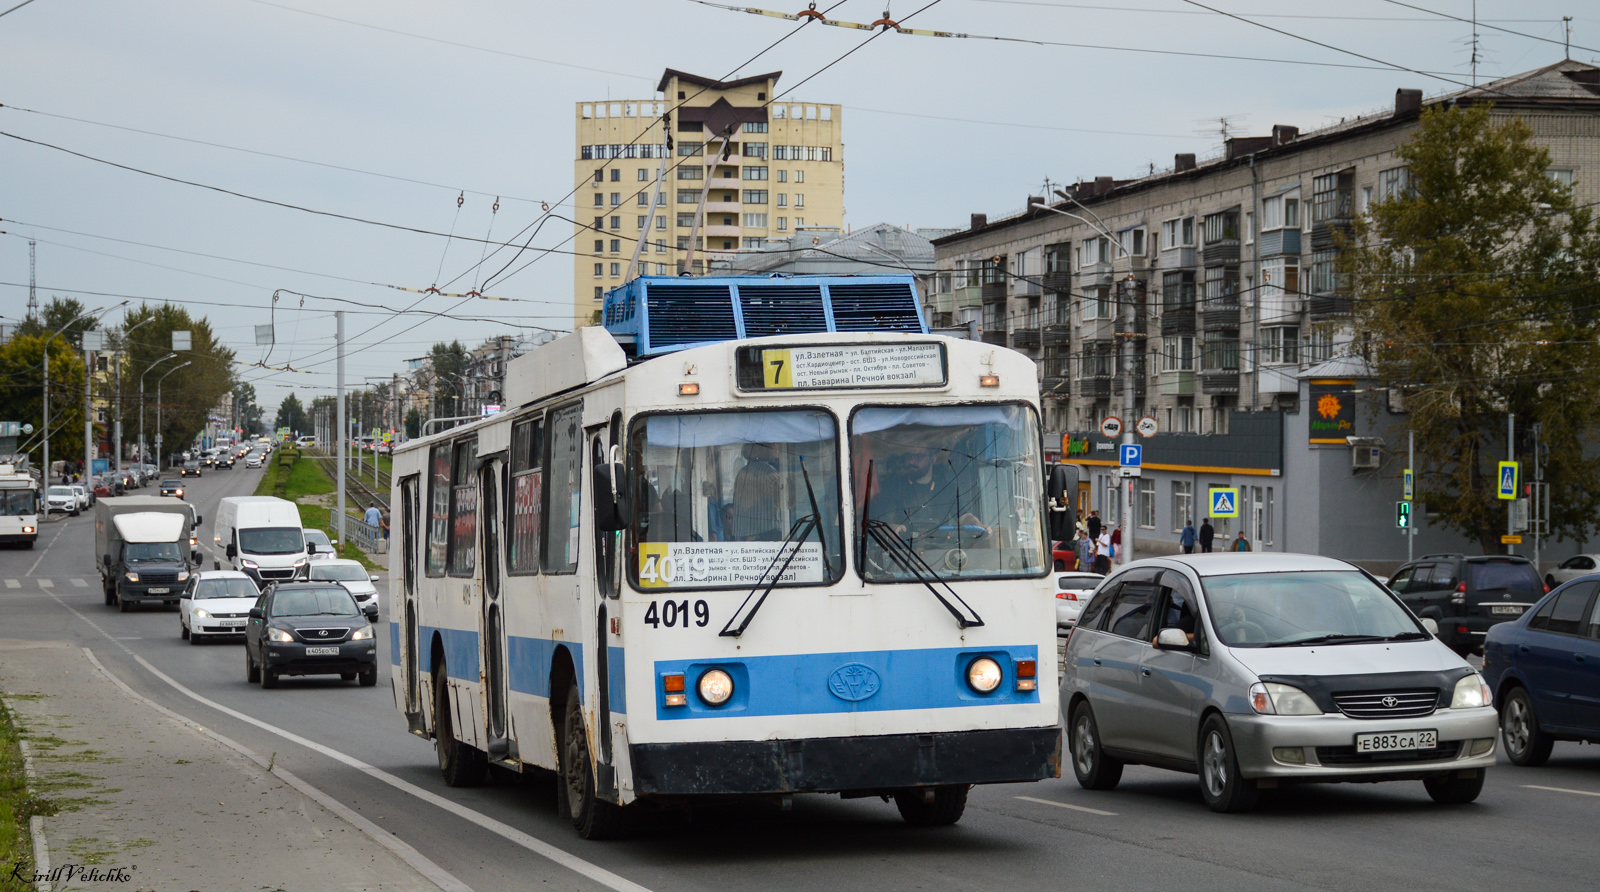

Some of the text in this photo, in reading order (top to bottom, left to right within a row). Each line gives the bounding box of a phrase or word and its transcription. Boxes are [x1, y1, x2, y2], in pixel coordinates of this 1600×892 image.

[860, 347, 894, 355] Балтийская
[770, 361, 784, 384] 7
[812, 378, 849, 386] Баварина
[1125, 447, 1138, 464] P
[640, 555, 709, 583] 4019
[645, 600, 709, 629] 4019
[1419, 733, 1432, 743] 22
